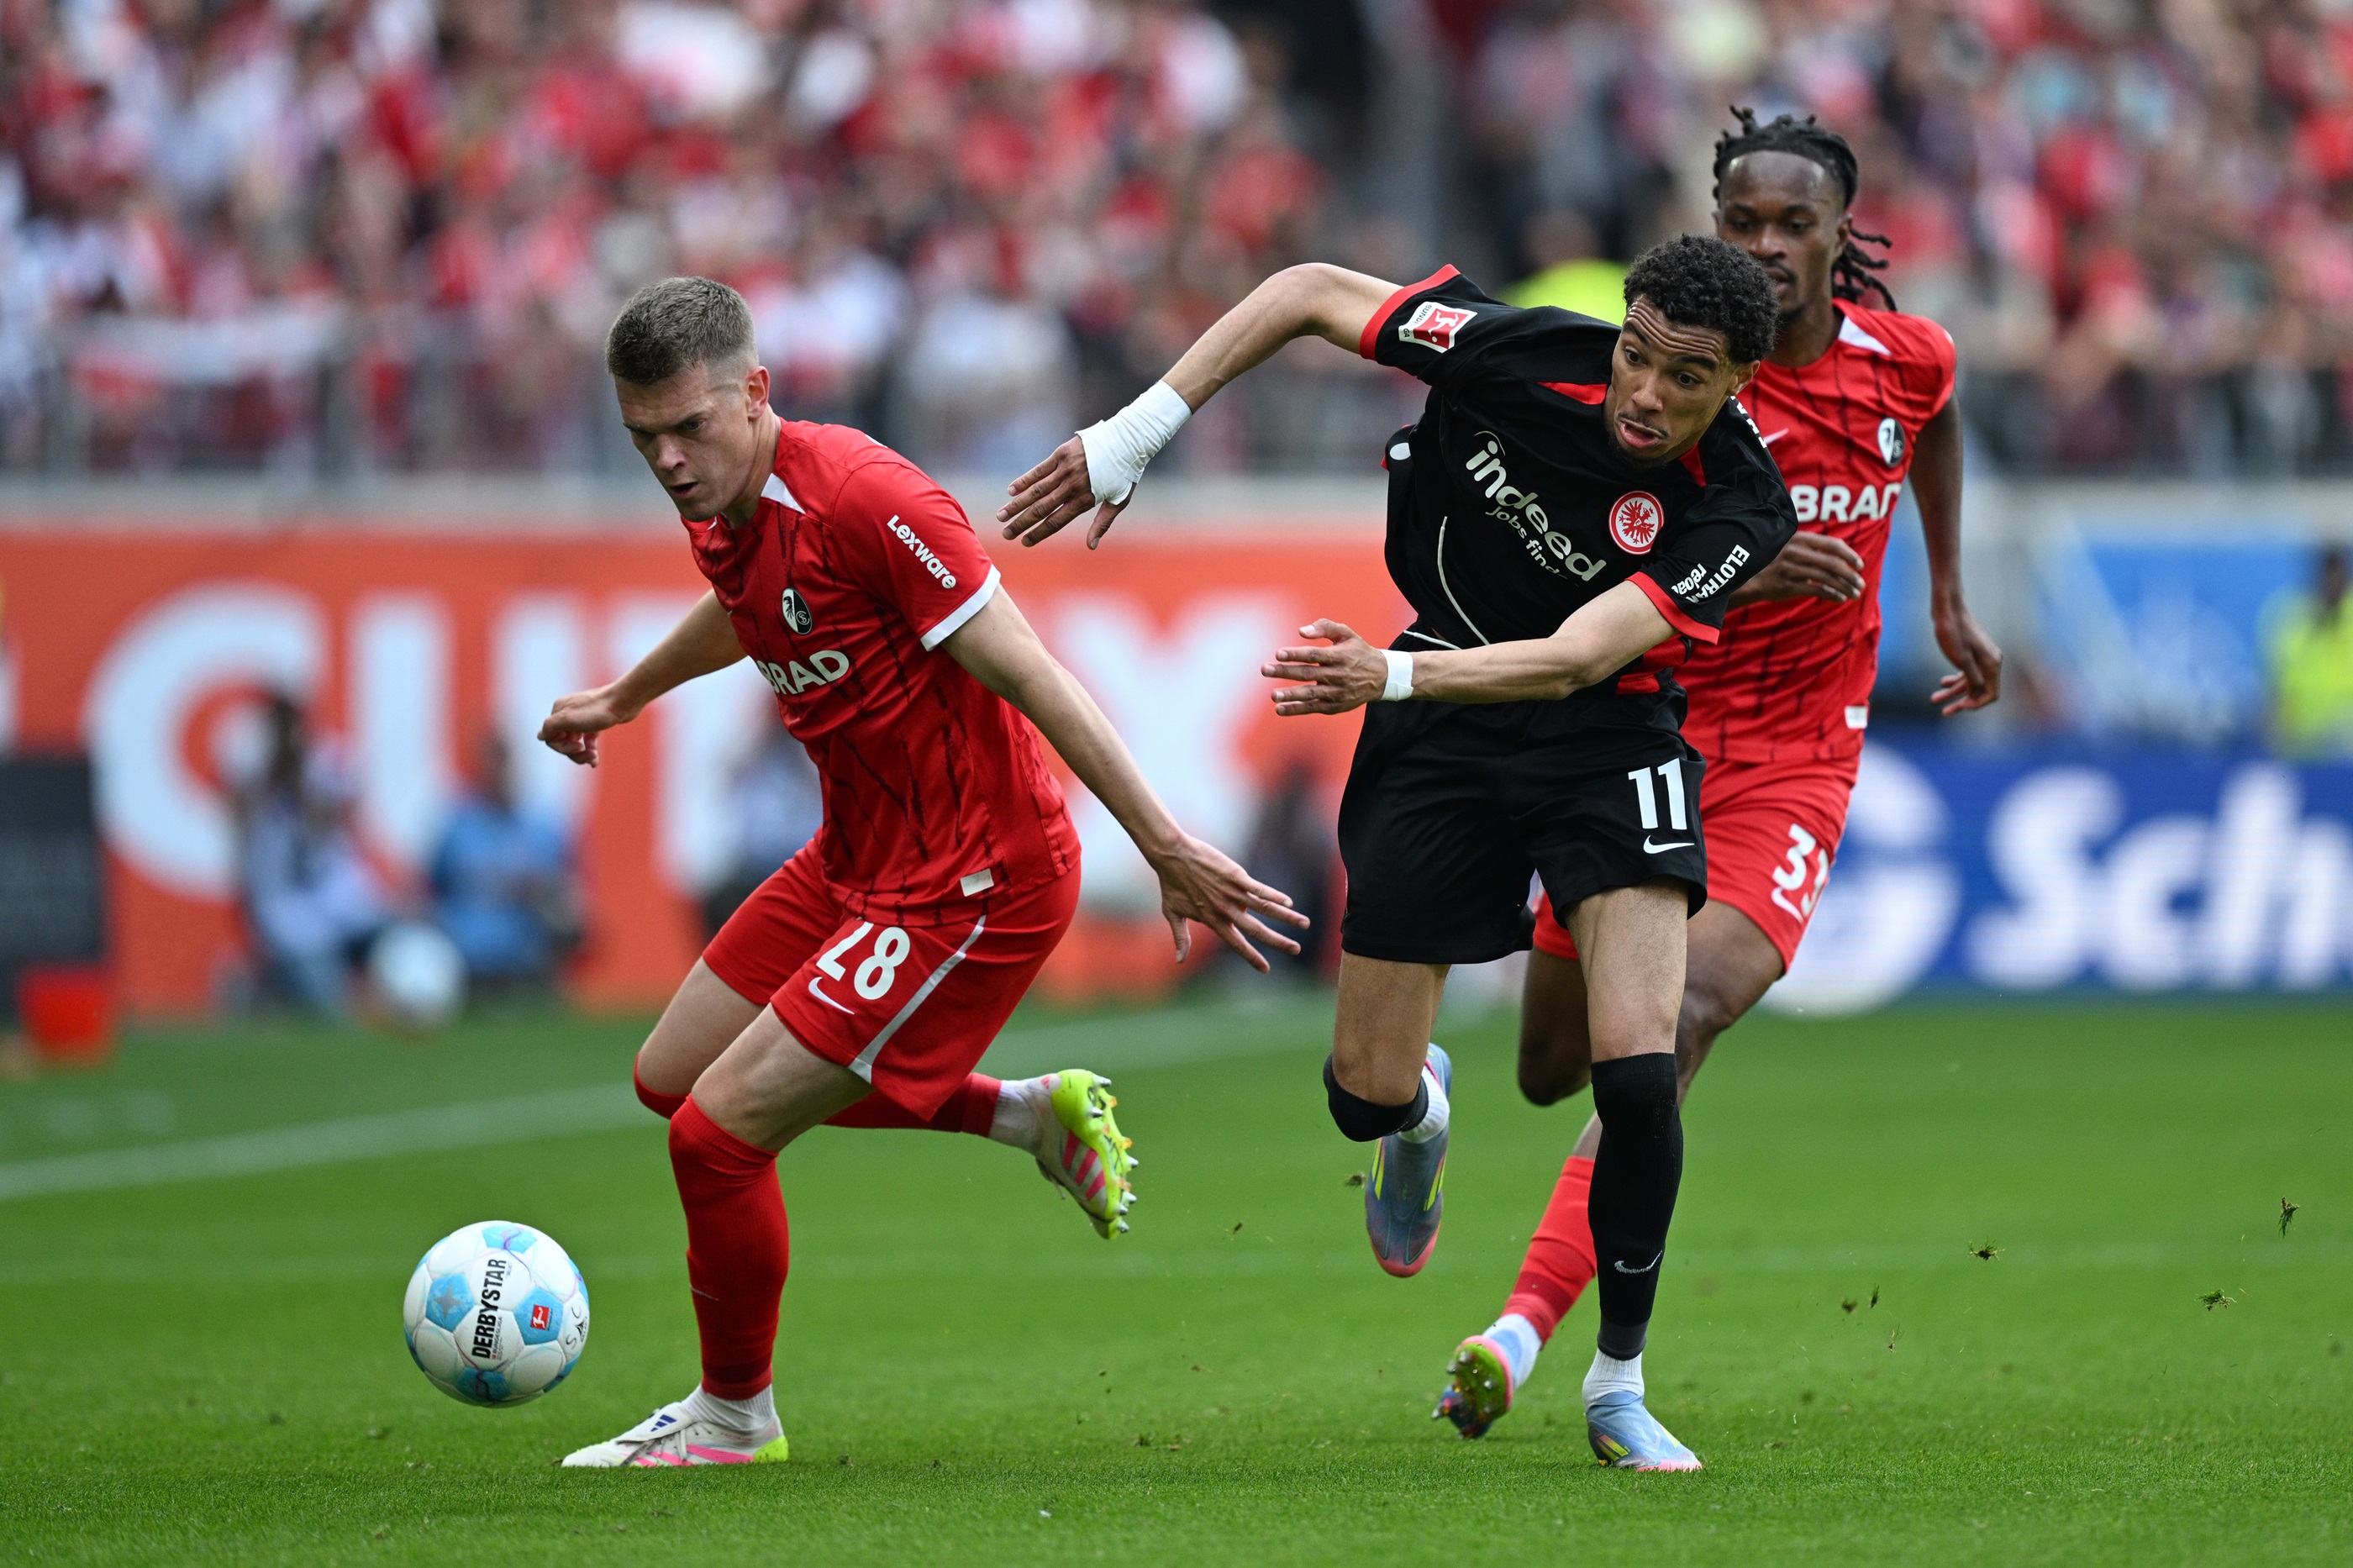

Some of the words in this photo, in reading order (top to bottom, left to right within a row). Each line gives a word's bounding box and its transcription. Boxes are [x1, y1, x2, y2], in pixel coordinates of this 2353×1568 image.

[1466, 432, 1607, 581] indeed
[1485, 506, 1527, 539] Jobs
[1525, 539, 1563, 576] find
[887, 514, 956, 589] Lexware
[1628, 758, 1687, 830] 11
[816, 917, 910, 1000] 28
[471, 1259, 507, 1359] DERBYSTAR
